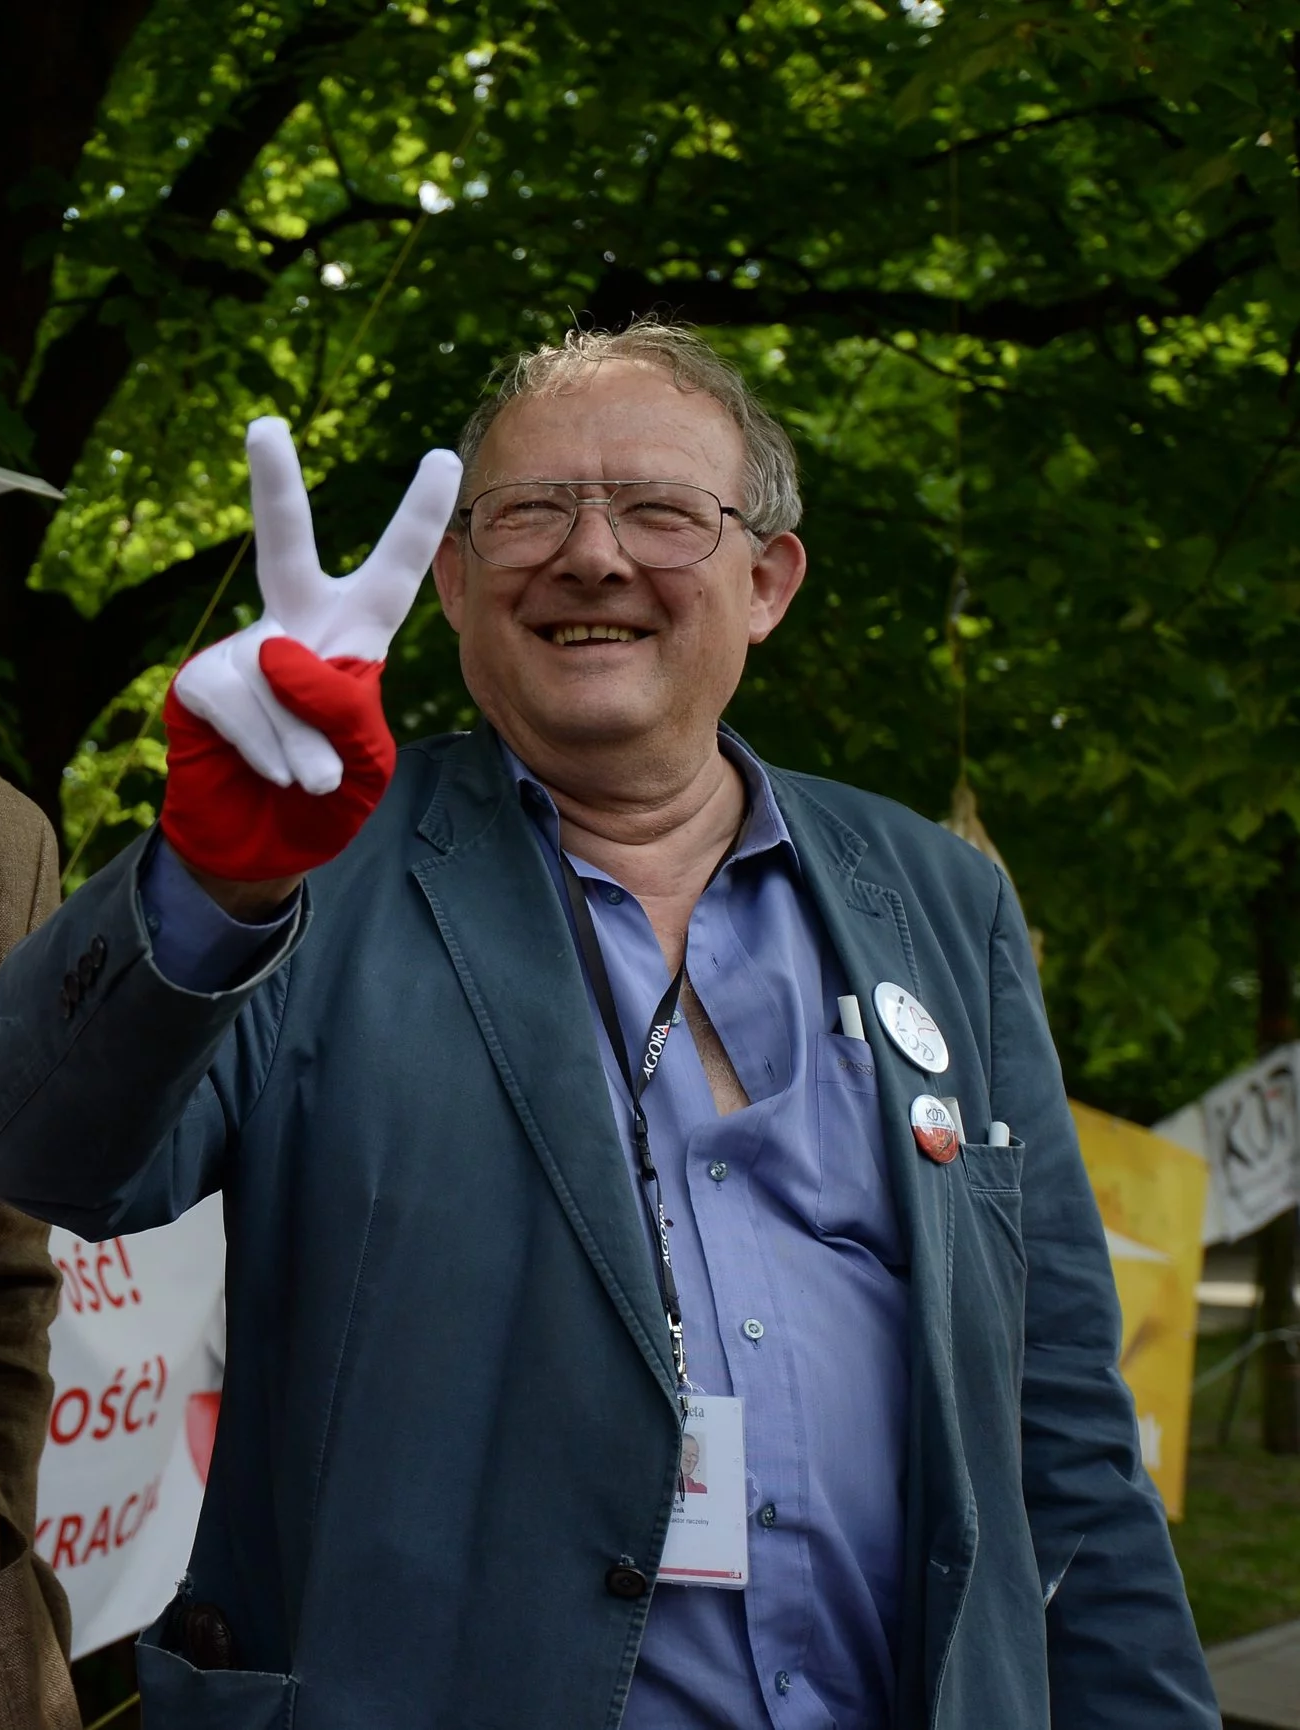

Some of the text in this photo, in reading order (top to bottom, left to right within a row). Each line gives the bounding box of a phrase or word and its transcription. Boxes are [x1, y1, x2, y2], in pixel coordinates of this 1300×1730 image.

[643, 1023, 670, 1081] AGORA
[926, 1108, 946, 1122] KOD
[49, 1355, 168, 1446] OŚĆ!
